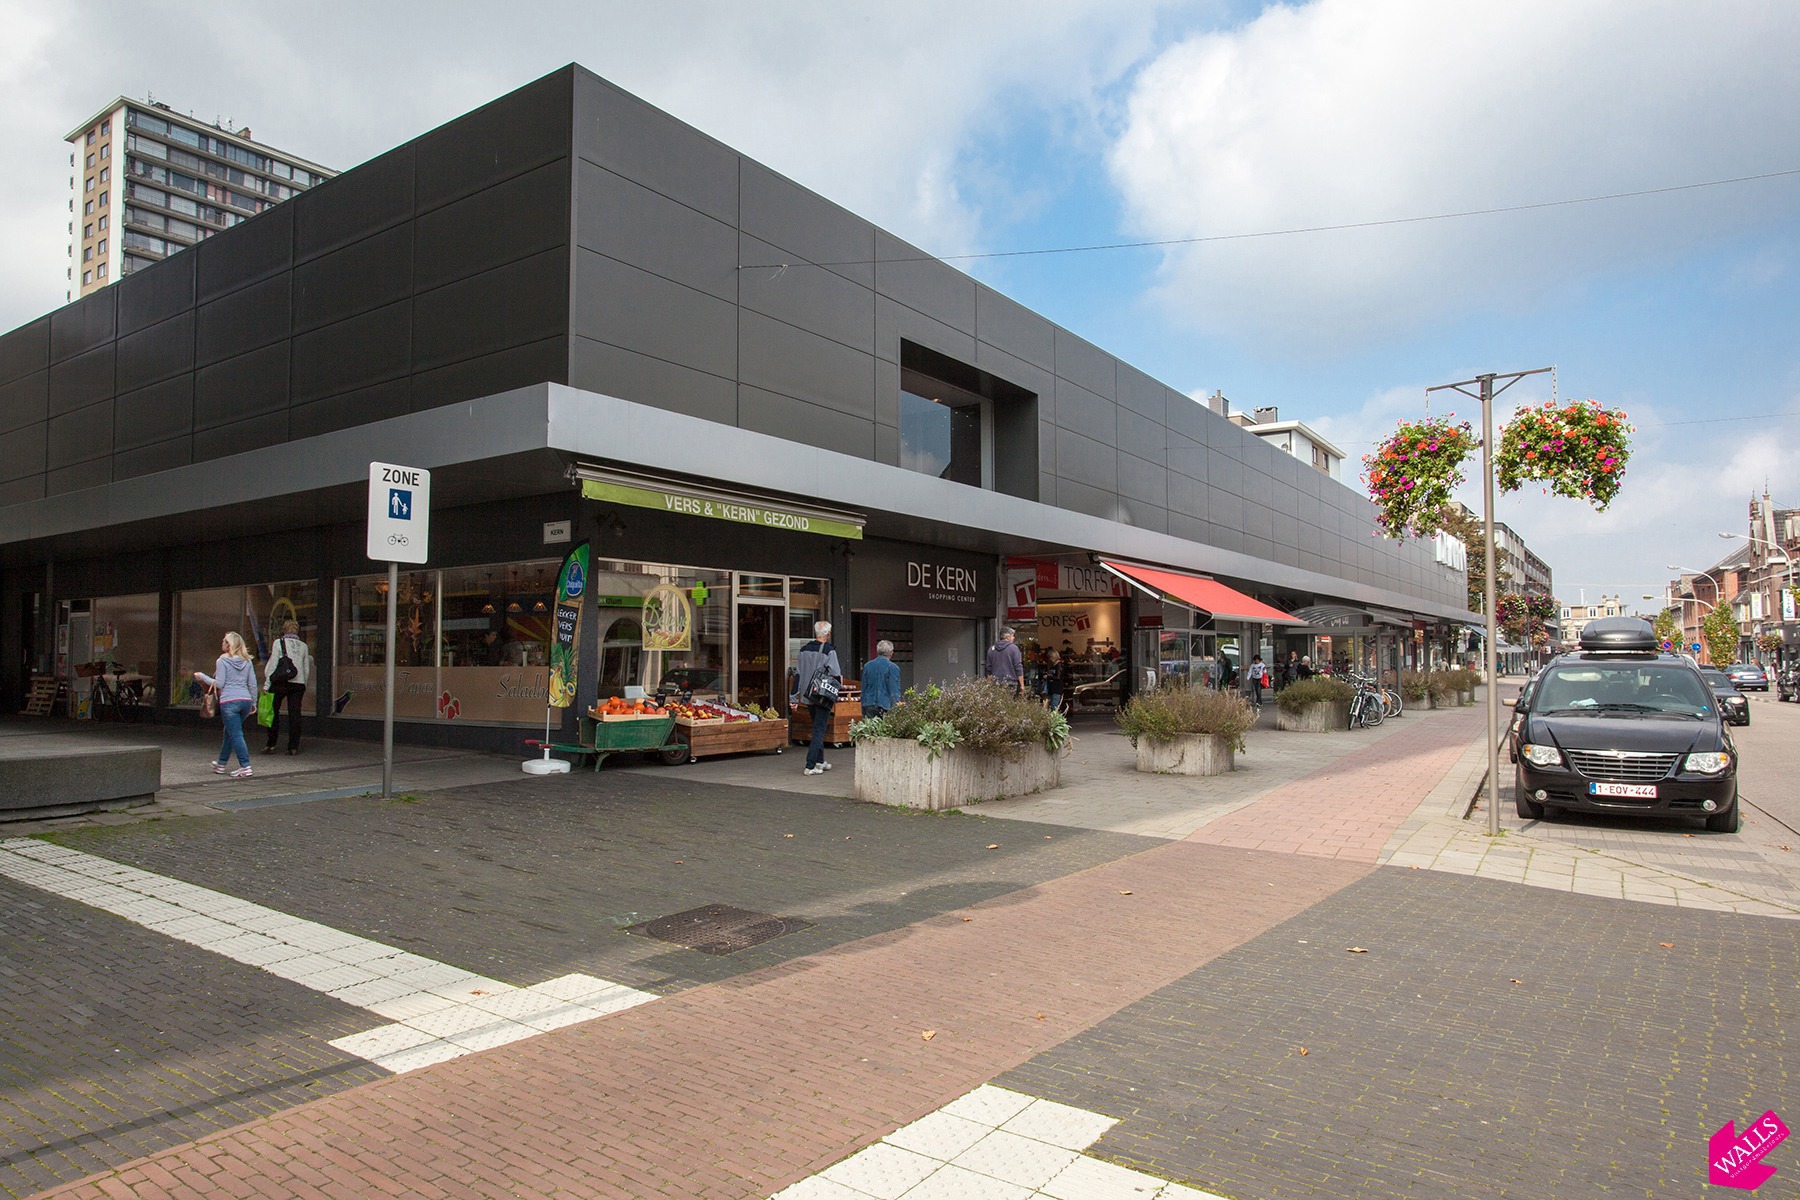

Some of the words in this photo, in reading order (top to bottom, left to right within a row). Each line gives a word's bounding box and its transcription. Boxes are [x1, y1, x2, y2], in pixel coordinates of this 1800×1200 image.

[382, 468, 420, 487] ZONE
[664, 494, 701, 514] VERS
[704, 501, 713, 516] &
[716, 503, 760, 522] "KERN"
[763, 510, 810, 531] GEZOND
[907, 561, 931, 588] DE
[936, 565, 977, 593] KERN
[1063, 565, 1108, 593] TORFS
[928, 593, 956, 601] SHOPPING
[956, 595, 976, 603] CENTER
[558, 620, 573, 631] VERS
[398, 670, 434, 696] Tapas
[820, 682, 839, 696] LEZER
